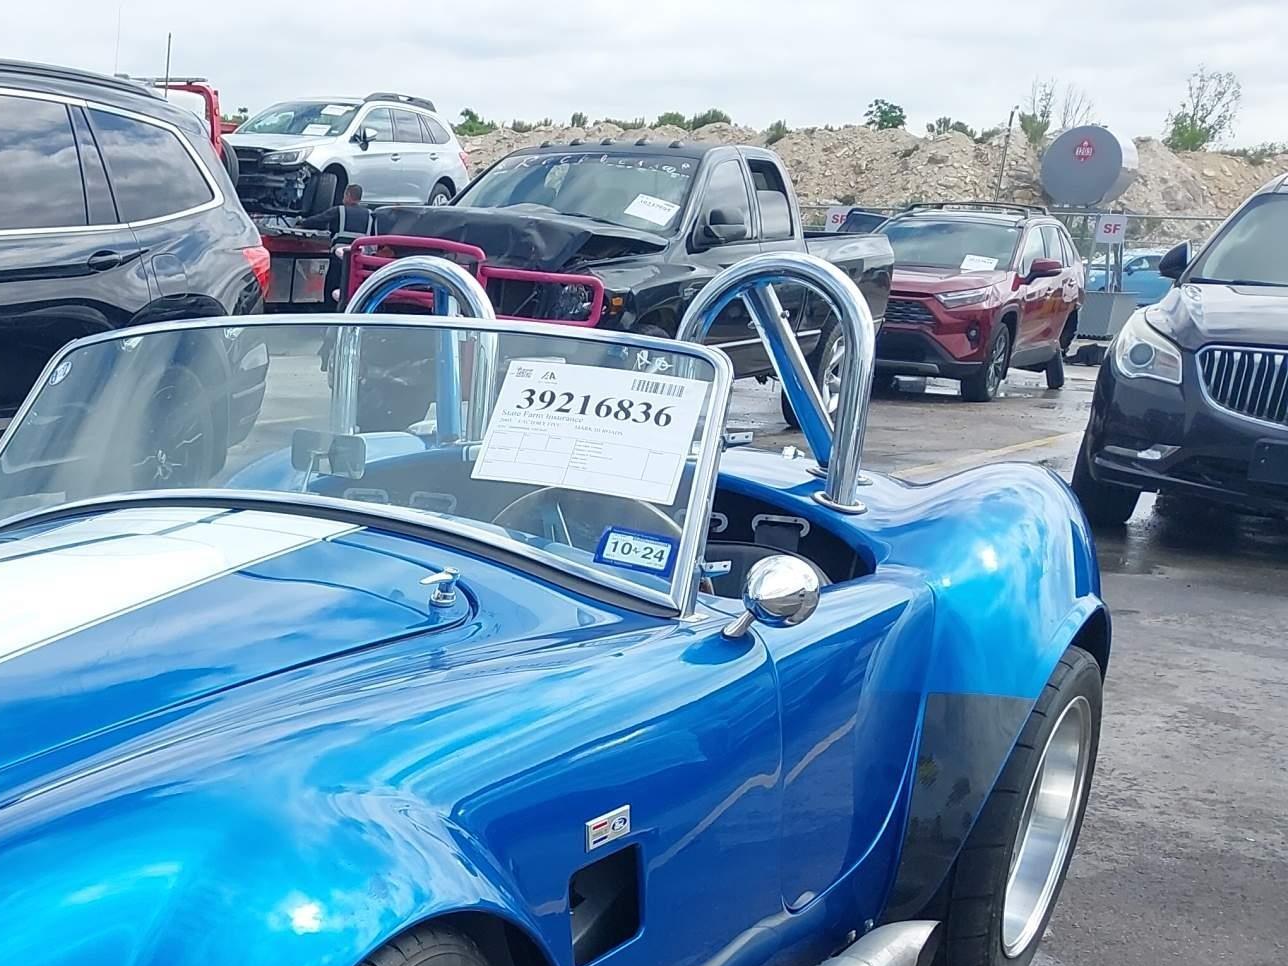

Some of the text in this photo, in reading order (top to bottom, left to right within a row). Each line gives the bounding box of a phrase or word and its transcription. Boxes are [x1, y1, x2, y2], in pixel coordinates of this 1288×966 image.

[1103, 223, 1121, 234] SF
[516, 388, 677, 427] 39216836
[523, 410, 544, 419] Farm
[612, 540, 633, 555] 10
[641, 546, 665, 562] 24
